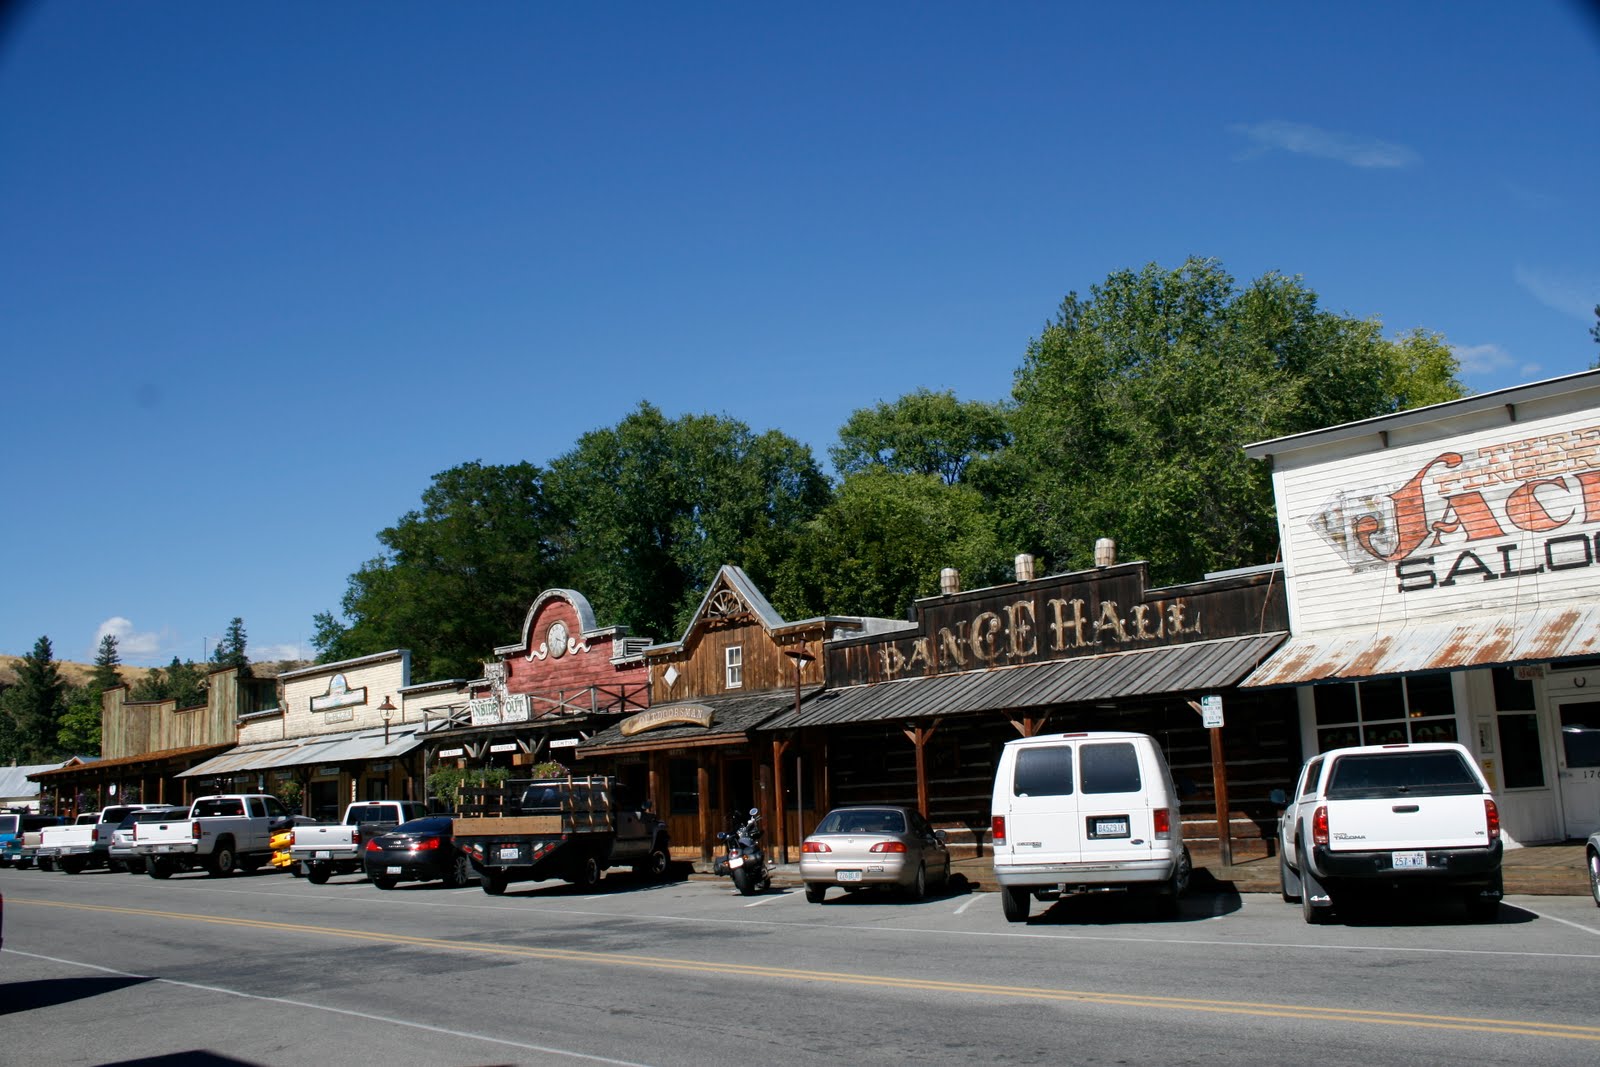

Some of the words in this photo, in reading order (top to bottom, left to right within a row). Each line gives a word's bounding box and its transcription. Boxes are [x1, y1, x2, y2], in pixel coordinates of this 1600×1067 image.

[1395, 530, 1600, 593] SALO
[877, 600, 1038, 674] DANCE
[1047, 597, 1202, 651] HALL
[471, 701, 499, 717] INSIDE
[505, 699, 524, 714] OUT
[640, 707, 703, 723] OUTDOORSMAN
